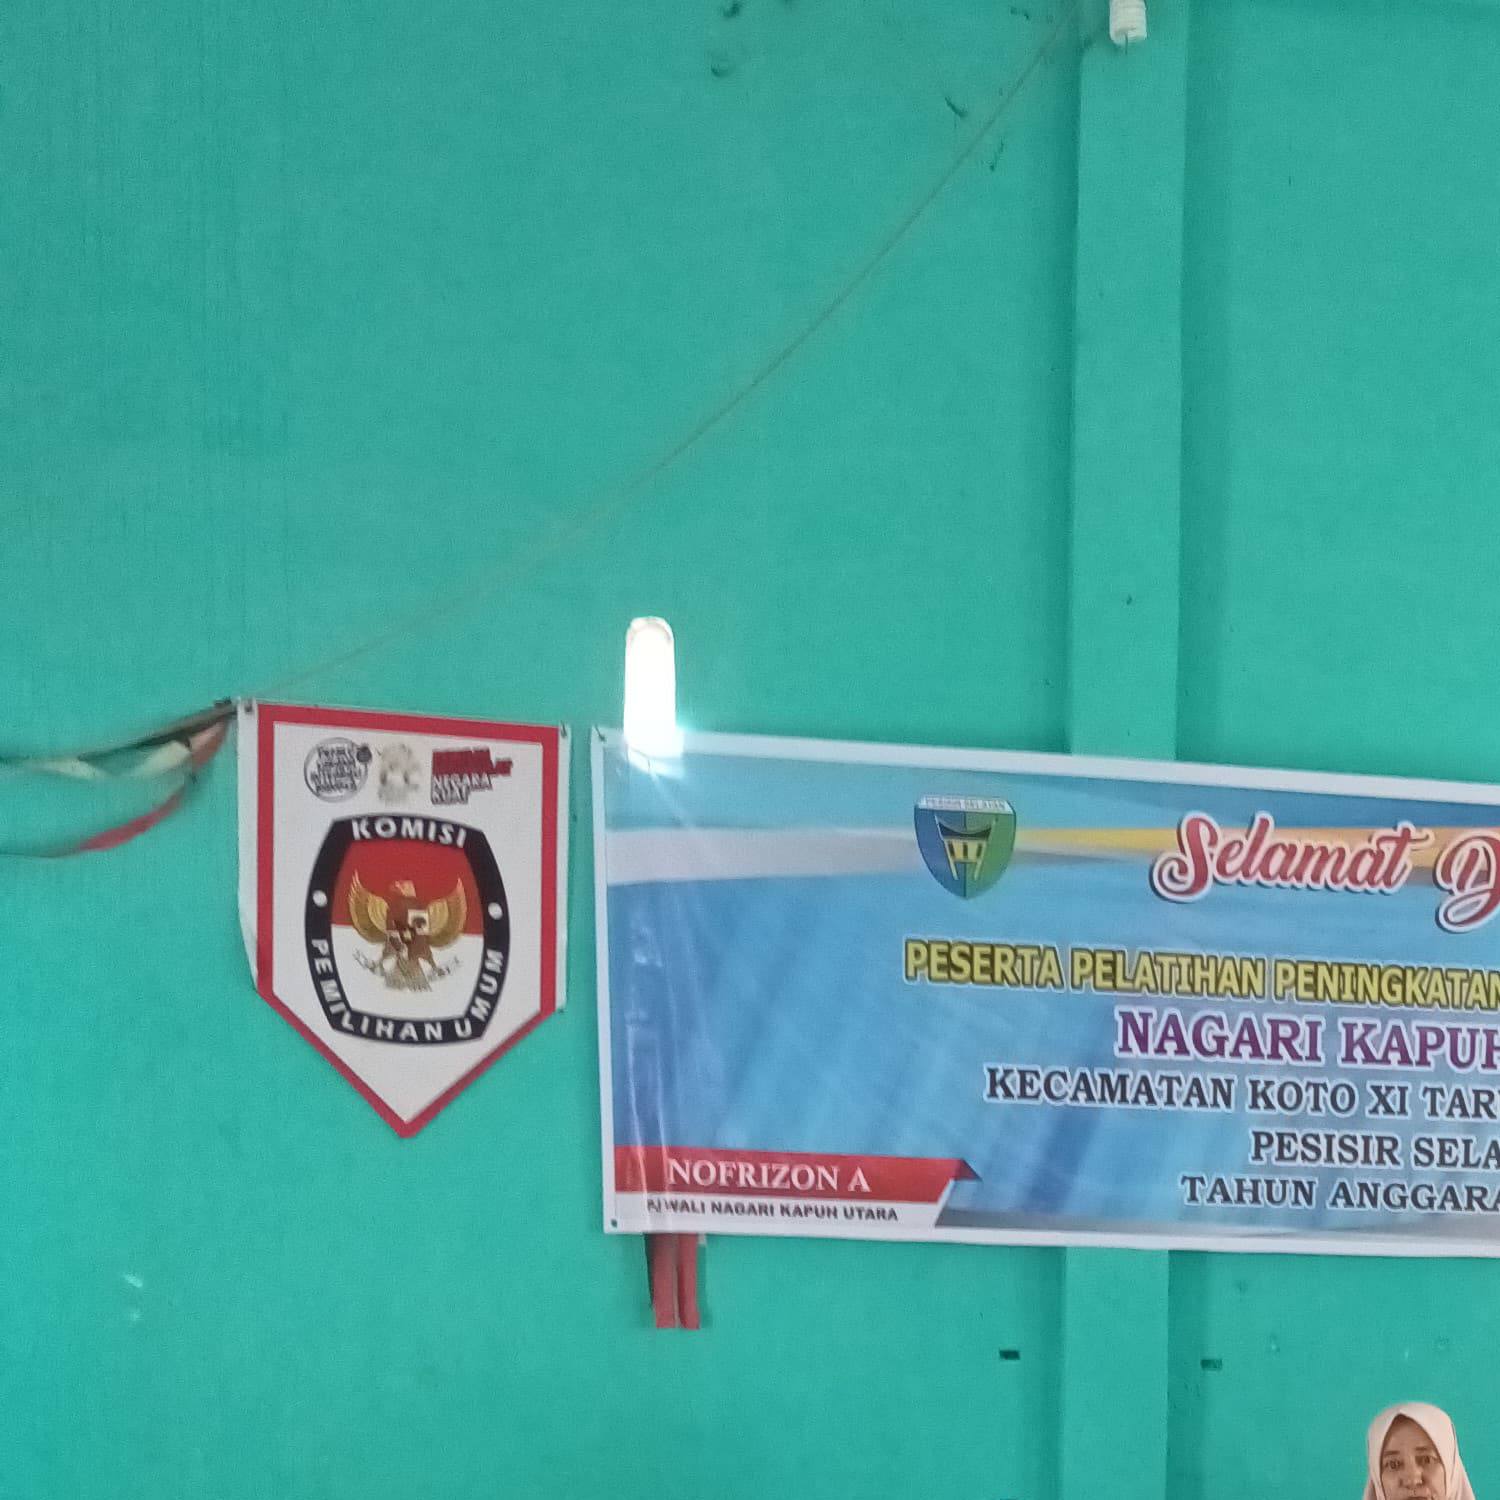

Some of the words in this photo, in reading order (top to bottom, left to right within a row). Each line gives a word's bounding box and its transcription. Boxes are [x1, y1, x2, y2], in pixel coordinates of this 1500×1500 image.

[351, 817, 466, 848] KOMISI
[1153, 813, 1434, 899] Selamat
[312, 939, 442, 1041] PEMILIHAN
[454, 949, 503, 1038] UMUM
[905, 940, 1064, 989] PESERTA
[1070, 948, 1266, 998] PELATIHAN
[1117, 1011, 1325, 1062] NAGARI
[986, 1067, 1234, 1109] KECAMATAN
[1248, 1078, 1356, 1114] KOTO
[1366, 1085, 1409, 1117] XI
[1251, 1131, 1400, 1166] PESISIR
[668, 1158, 839, 1191] NOFRIZON
[847, 1166, 872, 1193] A
[1180, 1175, 1316, 1209] TAHUN
[711, 1201, 775, 1218] NAGARI
[780, 1204, 838, 1220] KAPUH
[844, 1206, 899, 1222] UTARA
